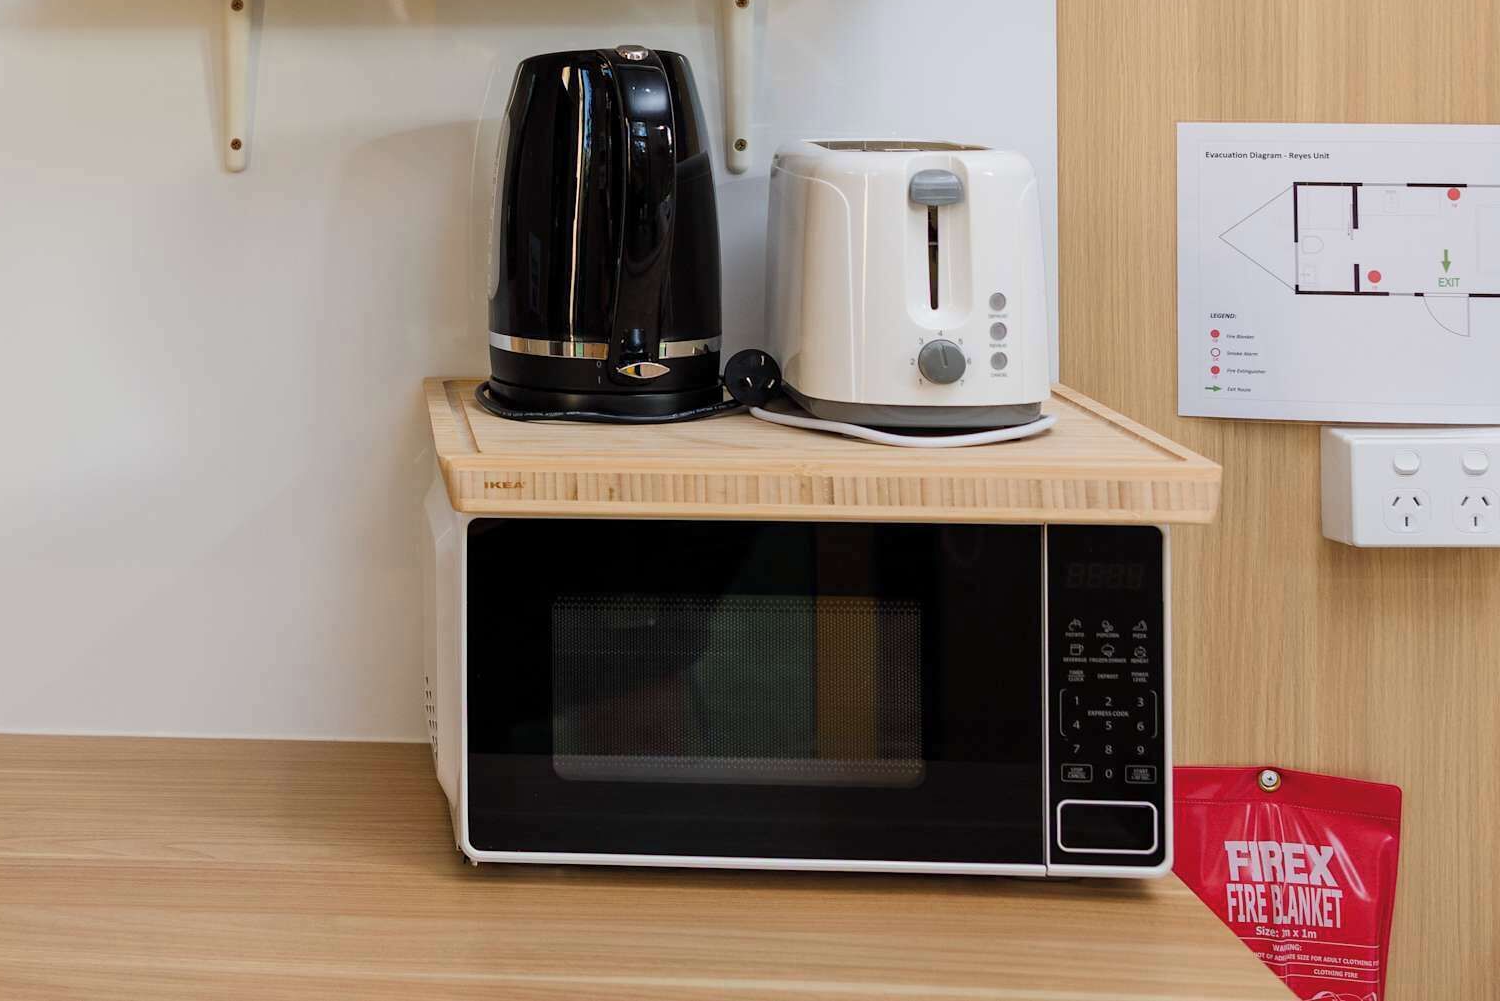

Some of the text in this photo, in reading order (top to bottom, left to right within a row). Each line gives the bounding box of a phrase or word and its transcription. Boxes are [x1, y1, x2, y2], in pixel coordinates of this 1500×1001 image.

[1205, 151, 1248, 159] Evacuation
[1250, 152, 1282, 161] Diagram
[1289, 152, 1311, 161] Reyes
[1438, 278, 1460, 288] EXIT
[484, 481, 524, 489] IKEA
[1075, 696, 1080, 705] 1
[1105, 697, 1112, 706] 2
[1137, 698, 1144, 707] 3
[1072, 720, 1080, 729] 4
[1105, 721, 1112, 730] 5
[1137, 722, 1144, 731] 6
[1073, 745, 1080, 754] 7
[1105, 745, 1112, 754] 8
[1137, 746, 1144, 755] 9
[1105, 769, 1112, 778] 0
[1224, 840, 1339, 887] FIREX
[1226, 883, 1343, 929] FIRE BLANKET
[1255, 926, 1279, 938] Size:
[1302, 929, 1317, 939] 1m
[1342, 958, 1372, 967] CLOTHING
[1314, 968, 1358, 979] CLOTHING FIRE
